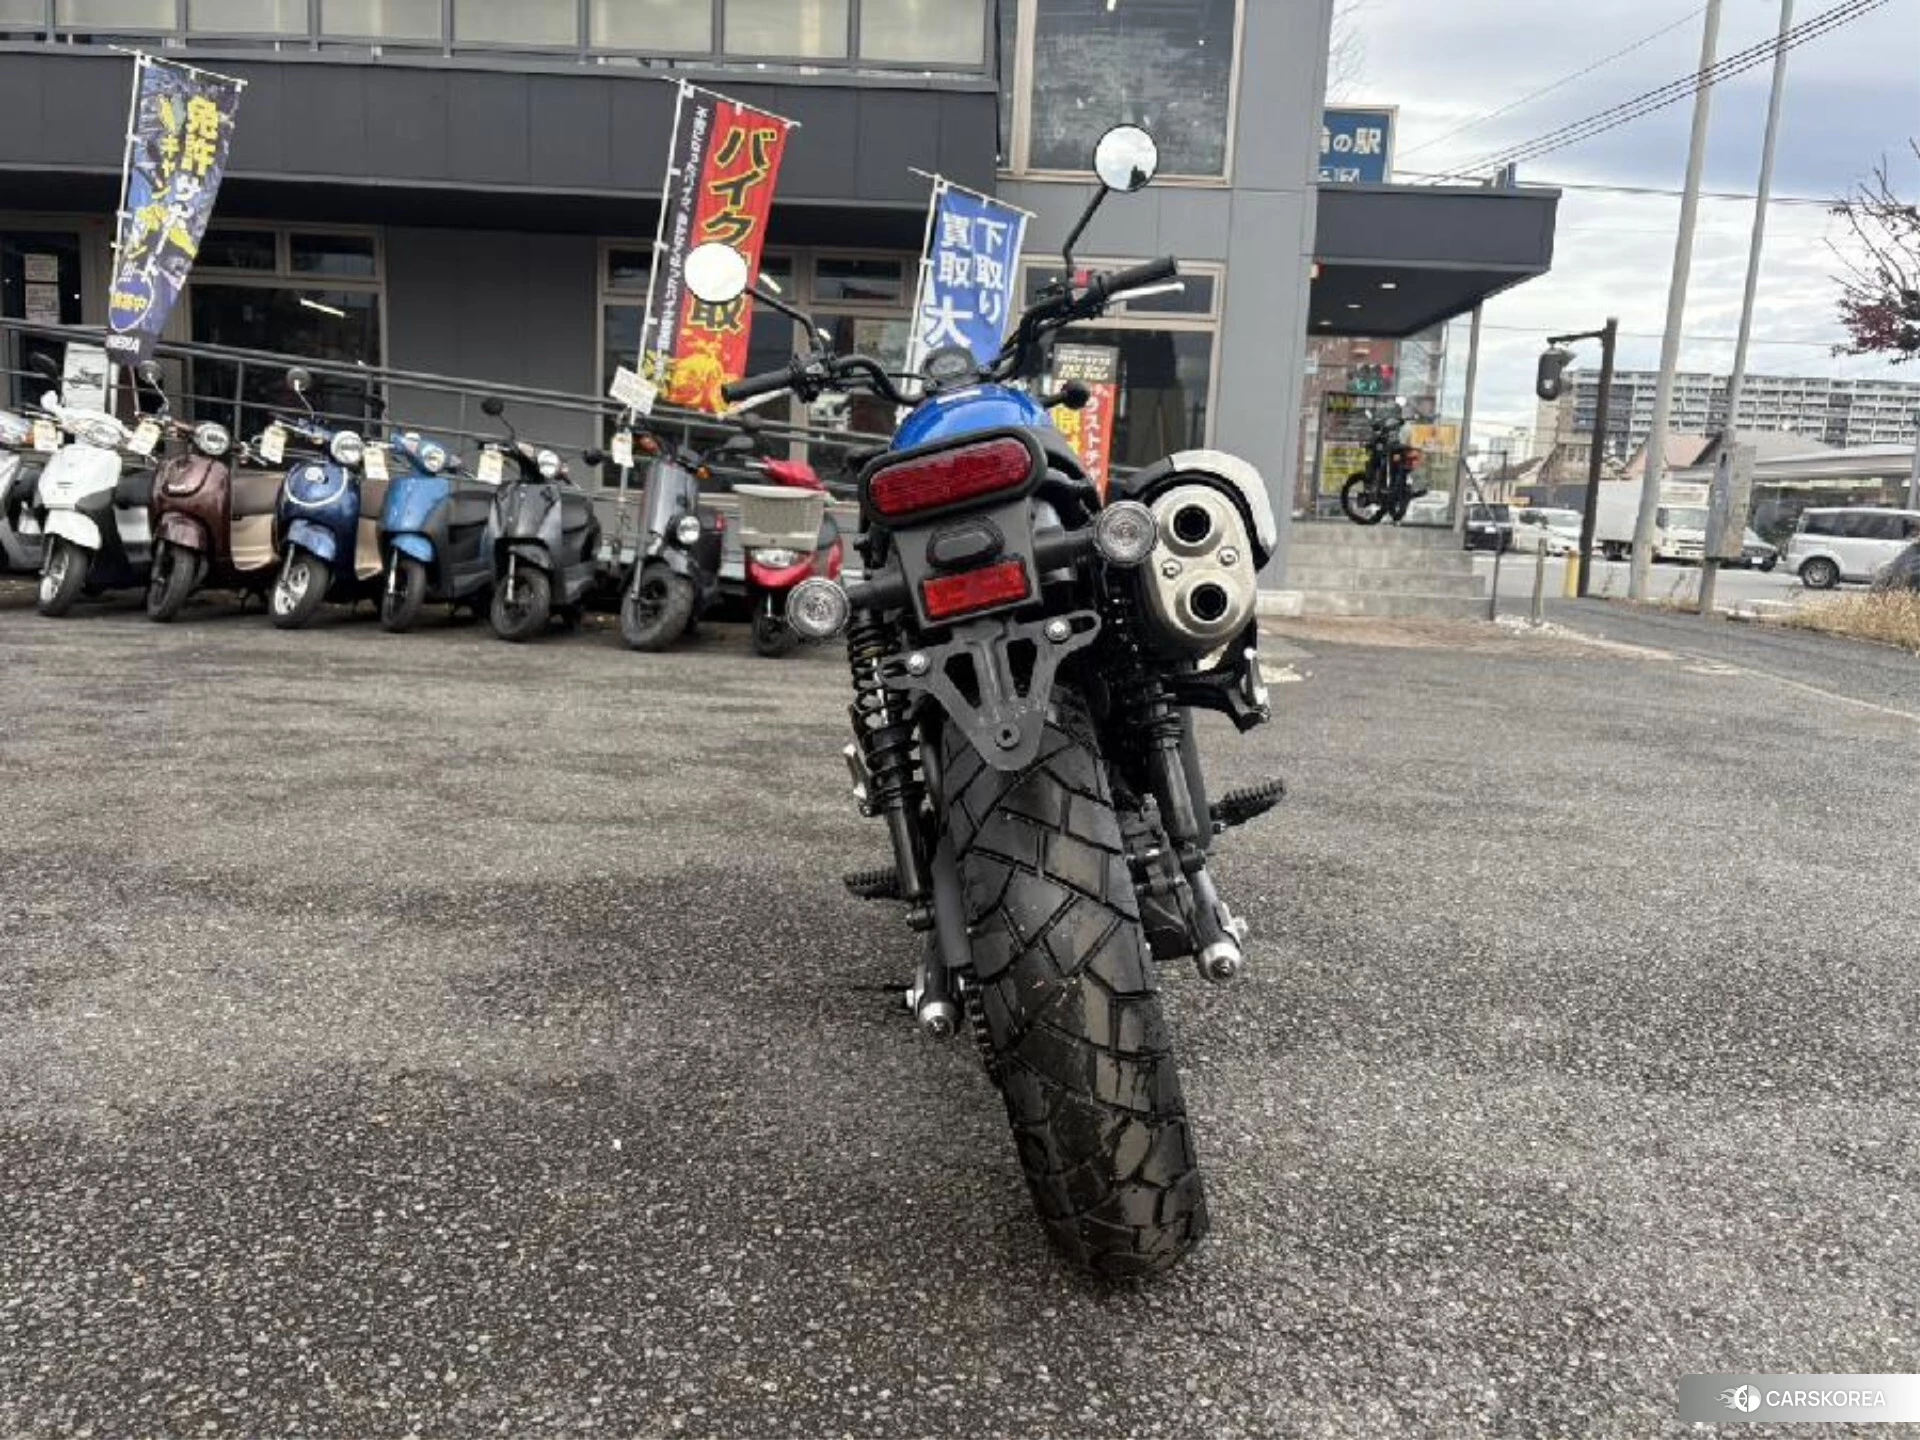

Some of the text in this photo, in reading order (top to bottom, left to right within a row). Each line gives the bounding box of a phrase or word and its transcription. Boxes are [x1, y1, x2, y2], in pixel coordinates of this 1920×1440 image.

[689, 126, 778, 333] バイク取
[973, 217, 1007, 324] 下取り
